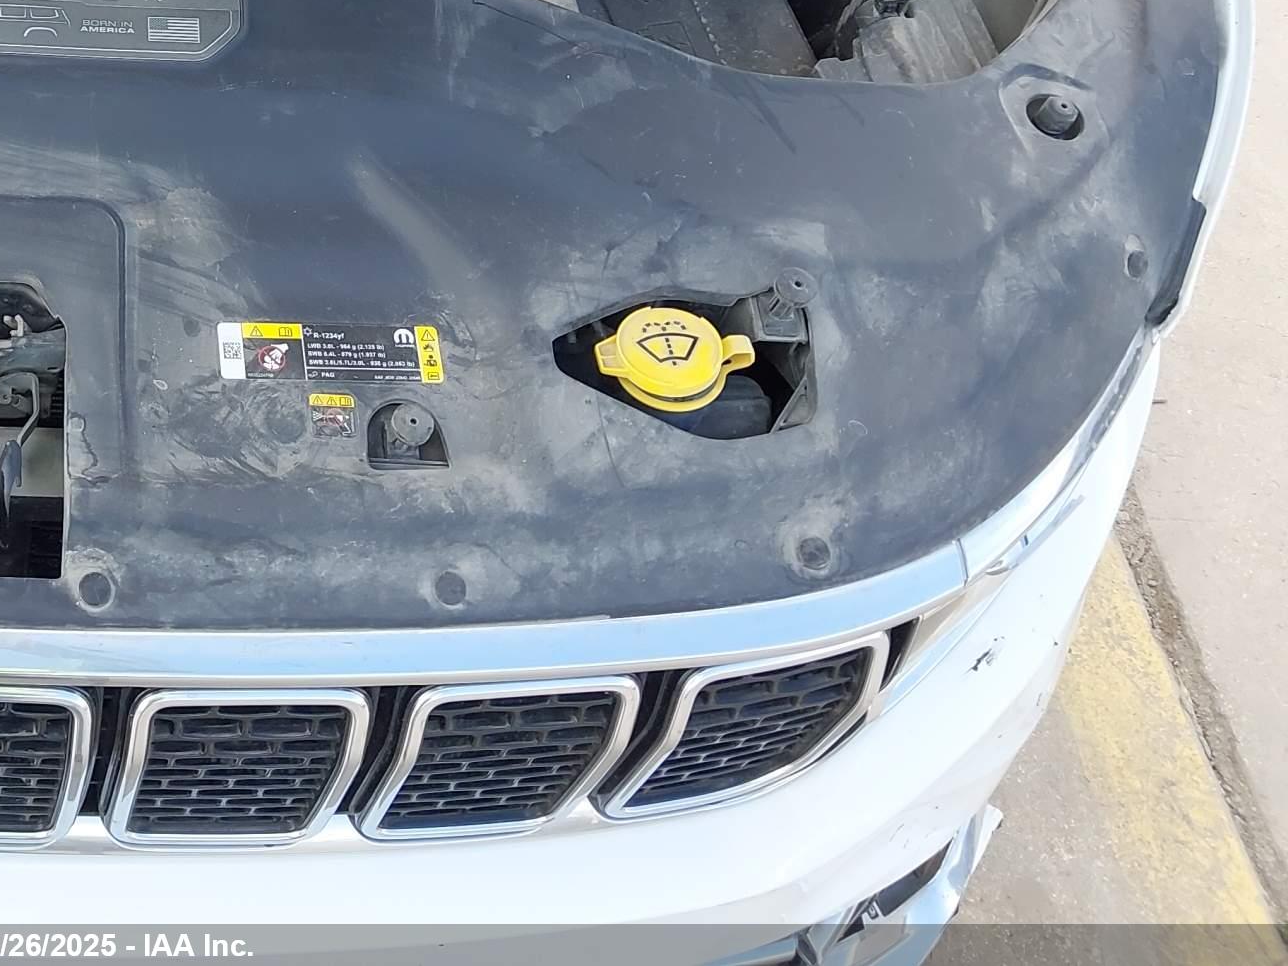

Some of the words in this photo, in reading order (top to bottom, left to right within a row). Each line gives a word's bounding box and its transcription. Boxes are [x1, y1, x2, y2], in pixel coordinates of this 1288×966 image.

[82, 19, 114, 27] BORN
[120, 20, 133, 28] IN
[80, 25, 135, 34] AMERICA
[313, 332, 345, 341] R-1234yf
